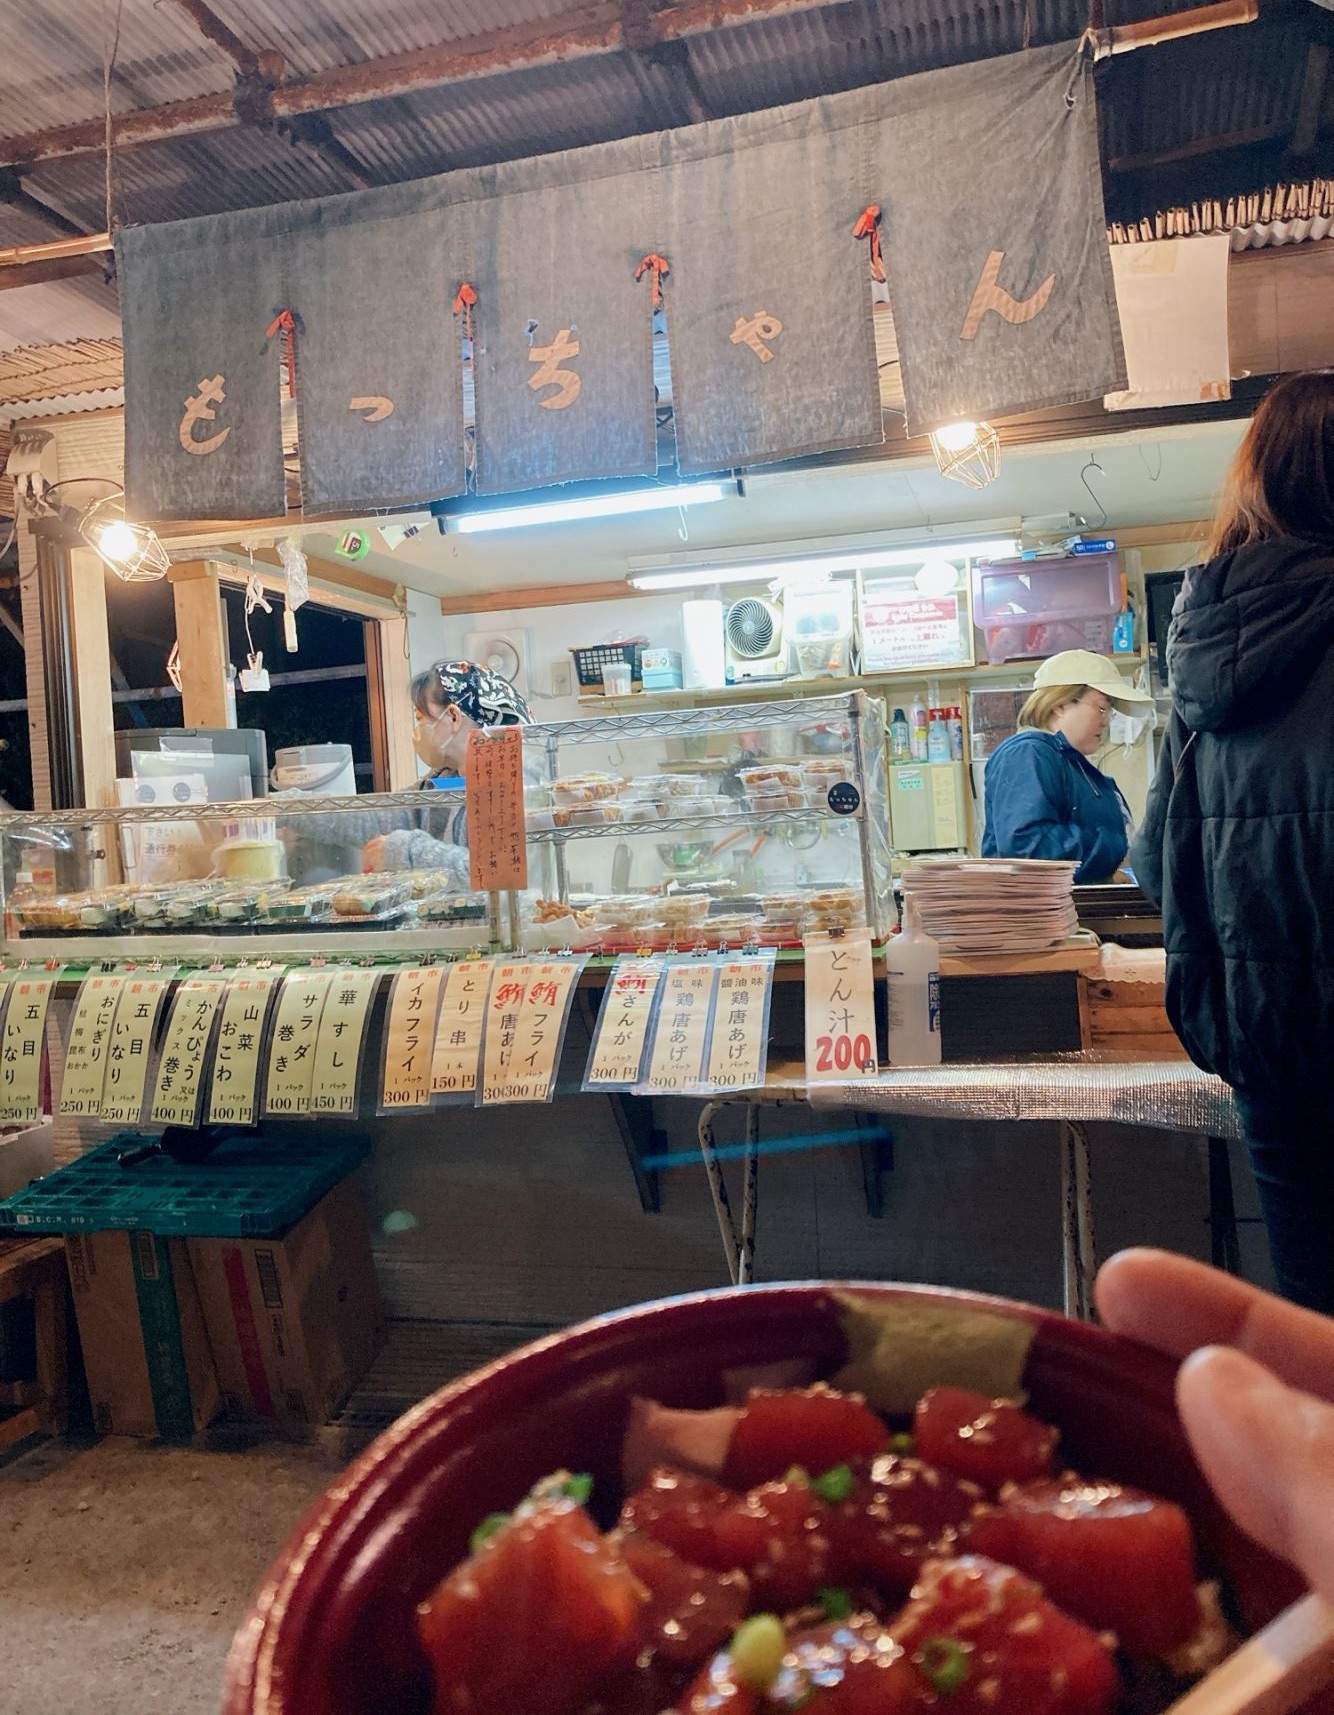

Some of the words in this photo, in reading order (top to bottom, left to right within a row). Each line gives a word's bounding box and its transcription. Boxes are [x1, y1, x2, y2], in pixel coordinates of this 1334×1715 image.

[449, 979, 475, 1046] とり串
[671, 979, 704, 989] 塩味
[827, 948, 856, 1035] とん汁
[4, 1025, 21, 1085] いなり
[23, 1004, 41, 1057] 五目
[91, 996, 115, 1062] おにぎり
[111, 1023, 130, 1085] いなり
[130, 1004, 151, 1056] 五目
[184, 1000, 212, 1081] かんぴょう
[216, 1022, 238, 1082] おこわ
[237, 1005, 259, 1051] 山菜
[275, 1024, 295, 1073] 巻き
[294, 994, 319, 1061] サラダ
[332, 989, 358, 1068] 華すし
[401, 982, 425, 1072] イカフライ
[669, 991, 695, 1063] 鶏唐あげ
[728, 990, 750, 1061] 鶏唐あげ
